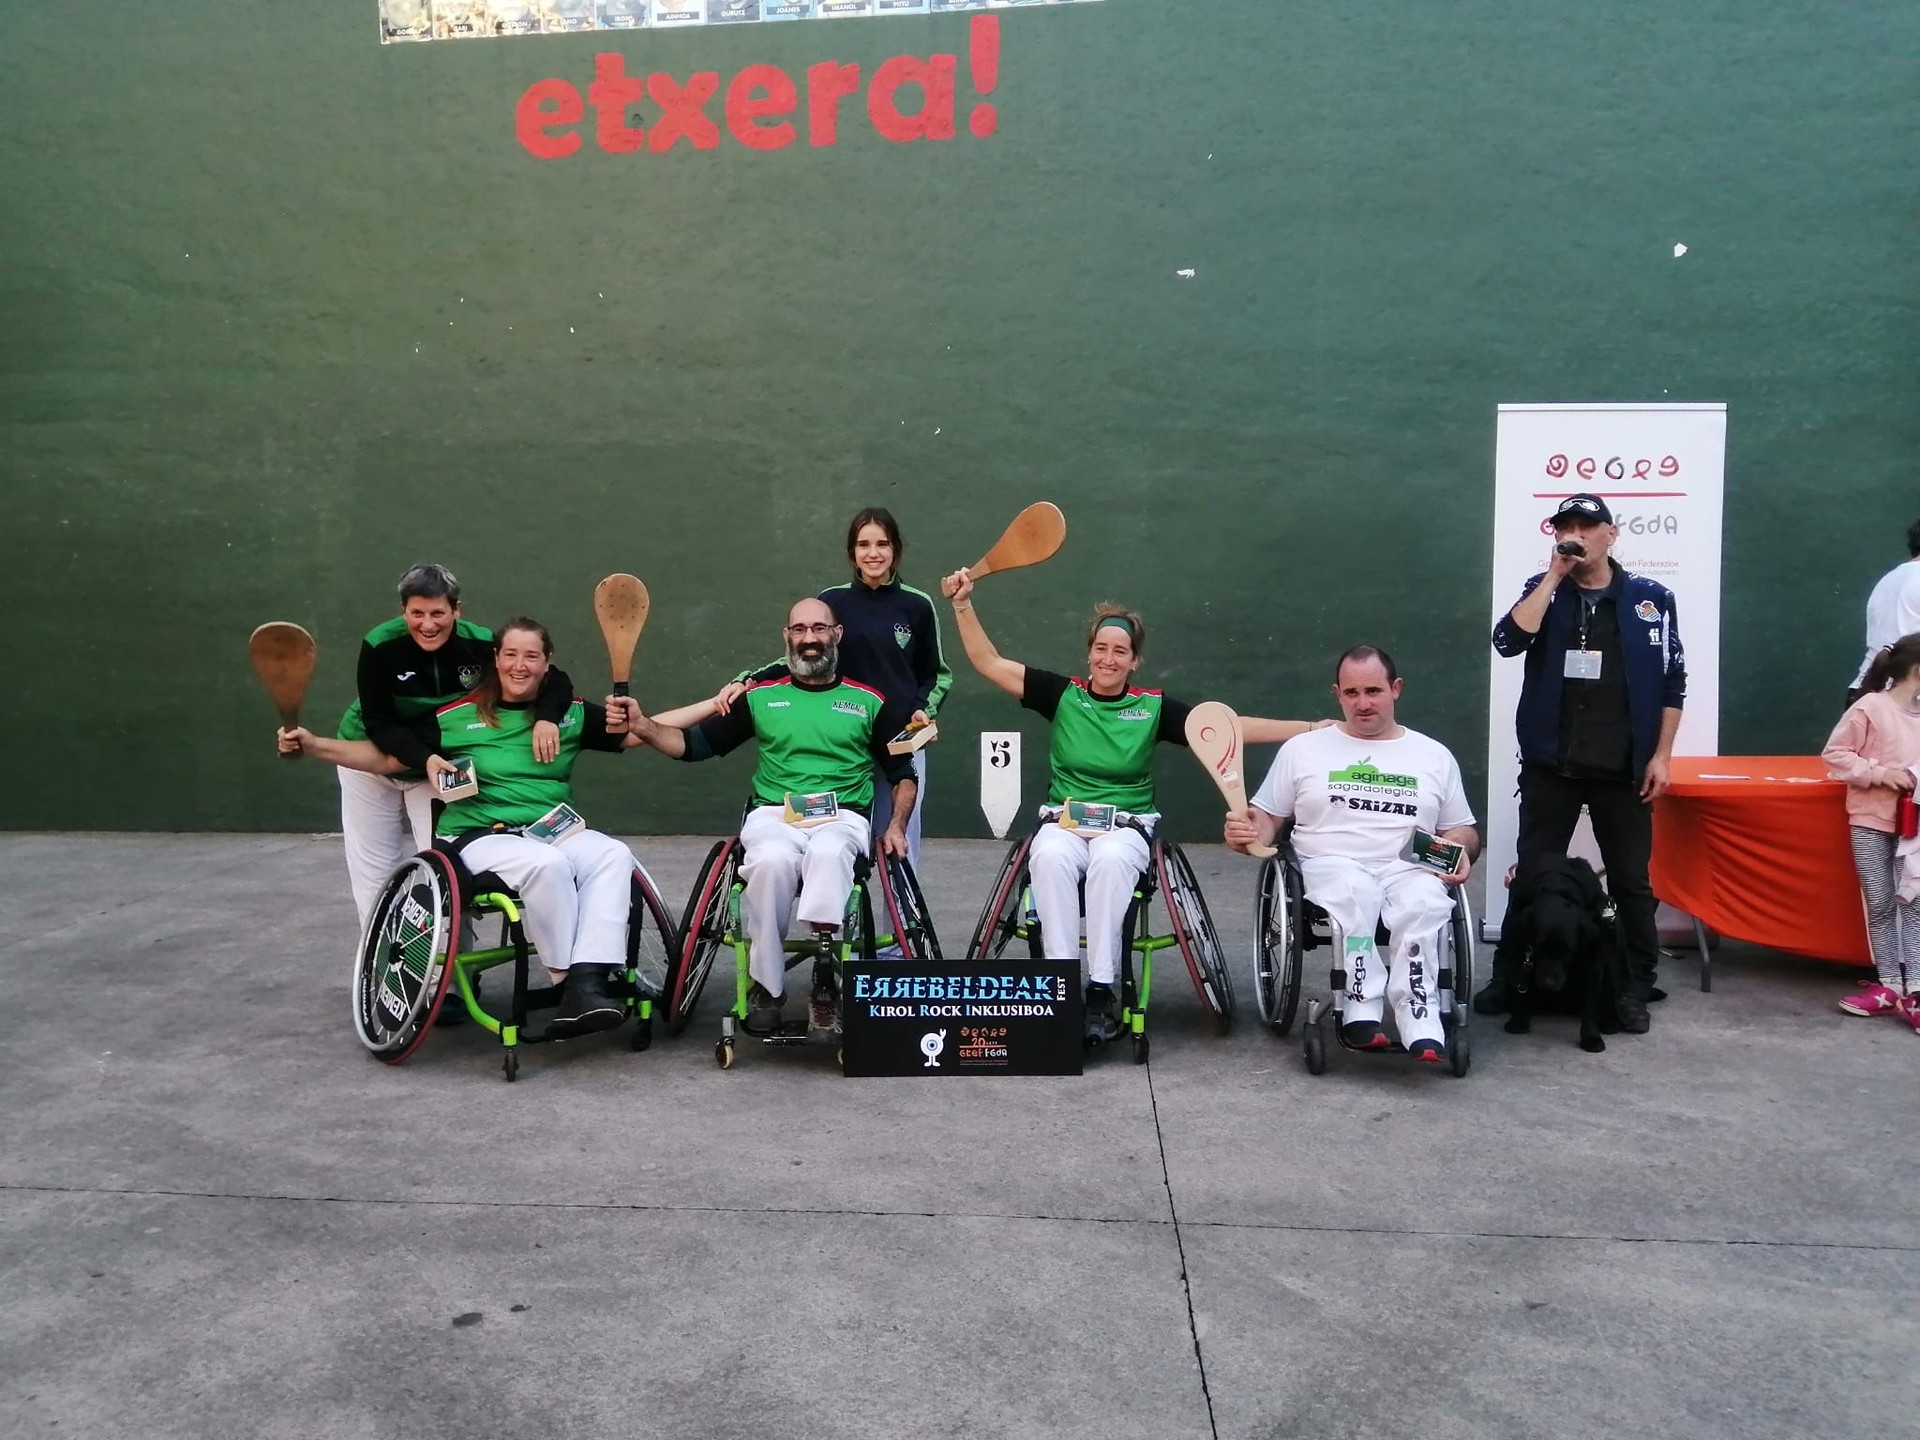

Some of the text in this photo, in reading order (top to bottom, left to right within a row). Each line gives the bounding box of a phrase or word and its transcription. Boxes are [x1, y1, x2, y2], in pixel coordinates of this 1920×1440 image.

[831, 3, 857, 11] IMANOL
[515, 14, 1001, 160] etxera!
[990, 740, 1011, 768] 5
[1351, 770, 1417, 787] aginaga
[1328, 782, 1419, 798] sagardotegiak
[1056, 976, 1066, 1001] FEST
[971, 1037, 986, 1047] 20
